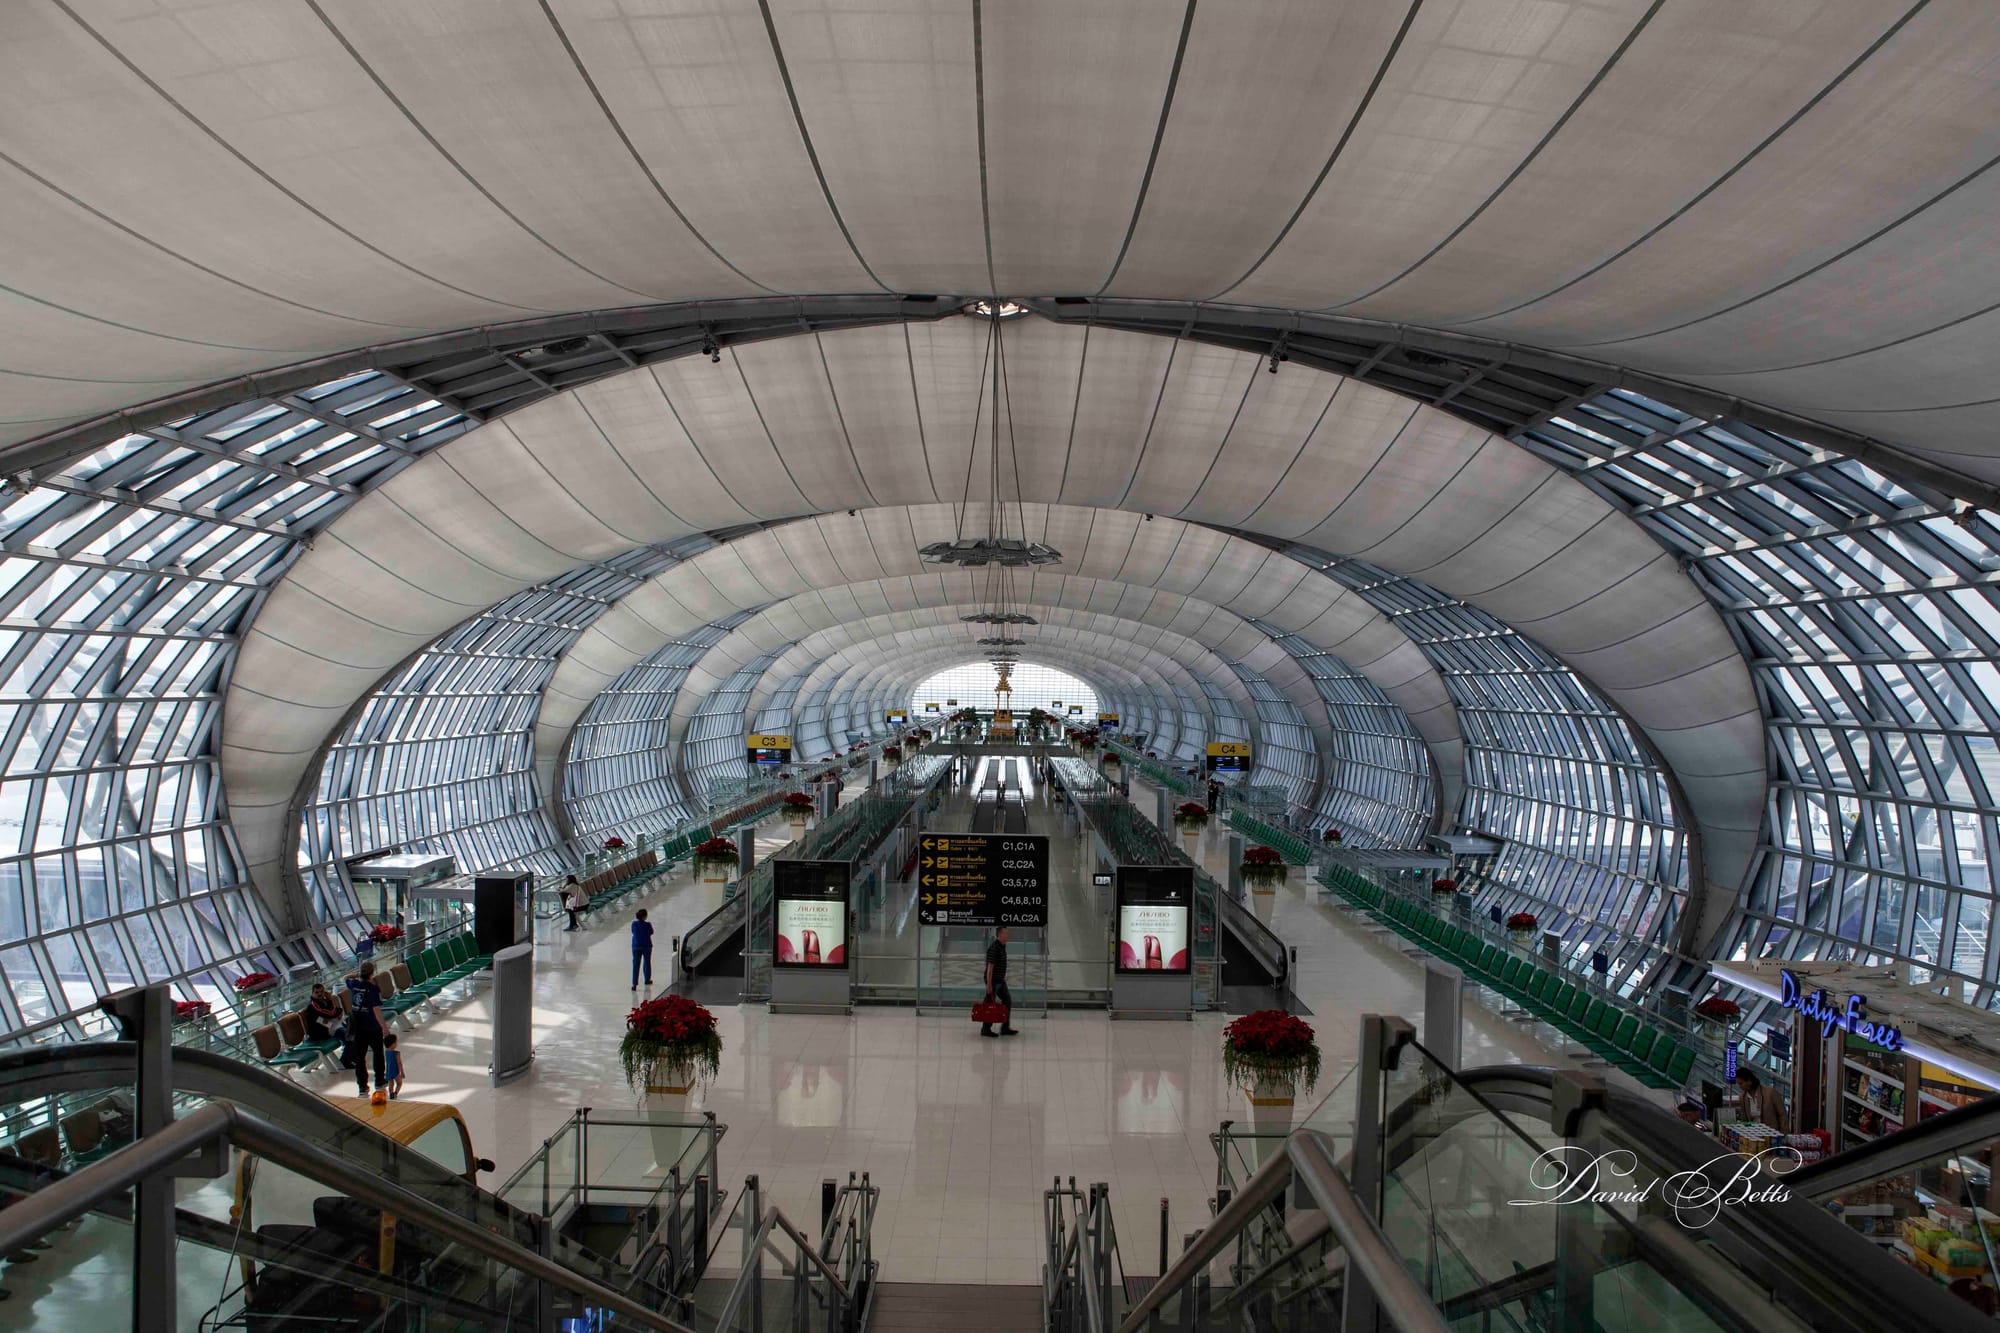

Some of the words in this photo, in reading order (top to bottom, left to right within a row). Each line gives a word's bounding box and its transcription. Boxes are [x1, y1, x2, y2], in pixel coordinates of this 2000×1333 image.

[761, 736, 777, 747] C3
[1221, 744, 1236, 754] C4
[1002, 841, 1036, 852] C1,C1A
[1002, 859, 1035, 870] C2,C2A
[1001, 878, 1038, 888] C3,5,7,9
[1001, 896, 1042, 906] C4,6,8,10
[1001, 913, 1040, 923] C1A,C2A
[1780, 968, 1837, 1038] Duty
[1846, 994, 1904, 1051] Free
